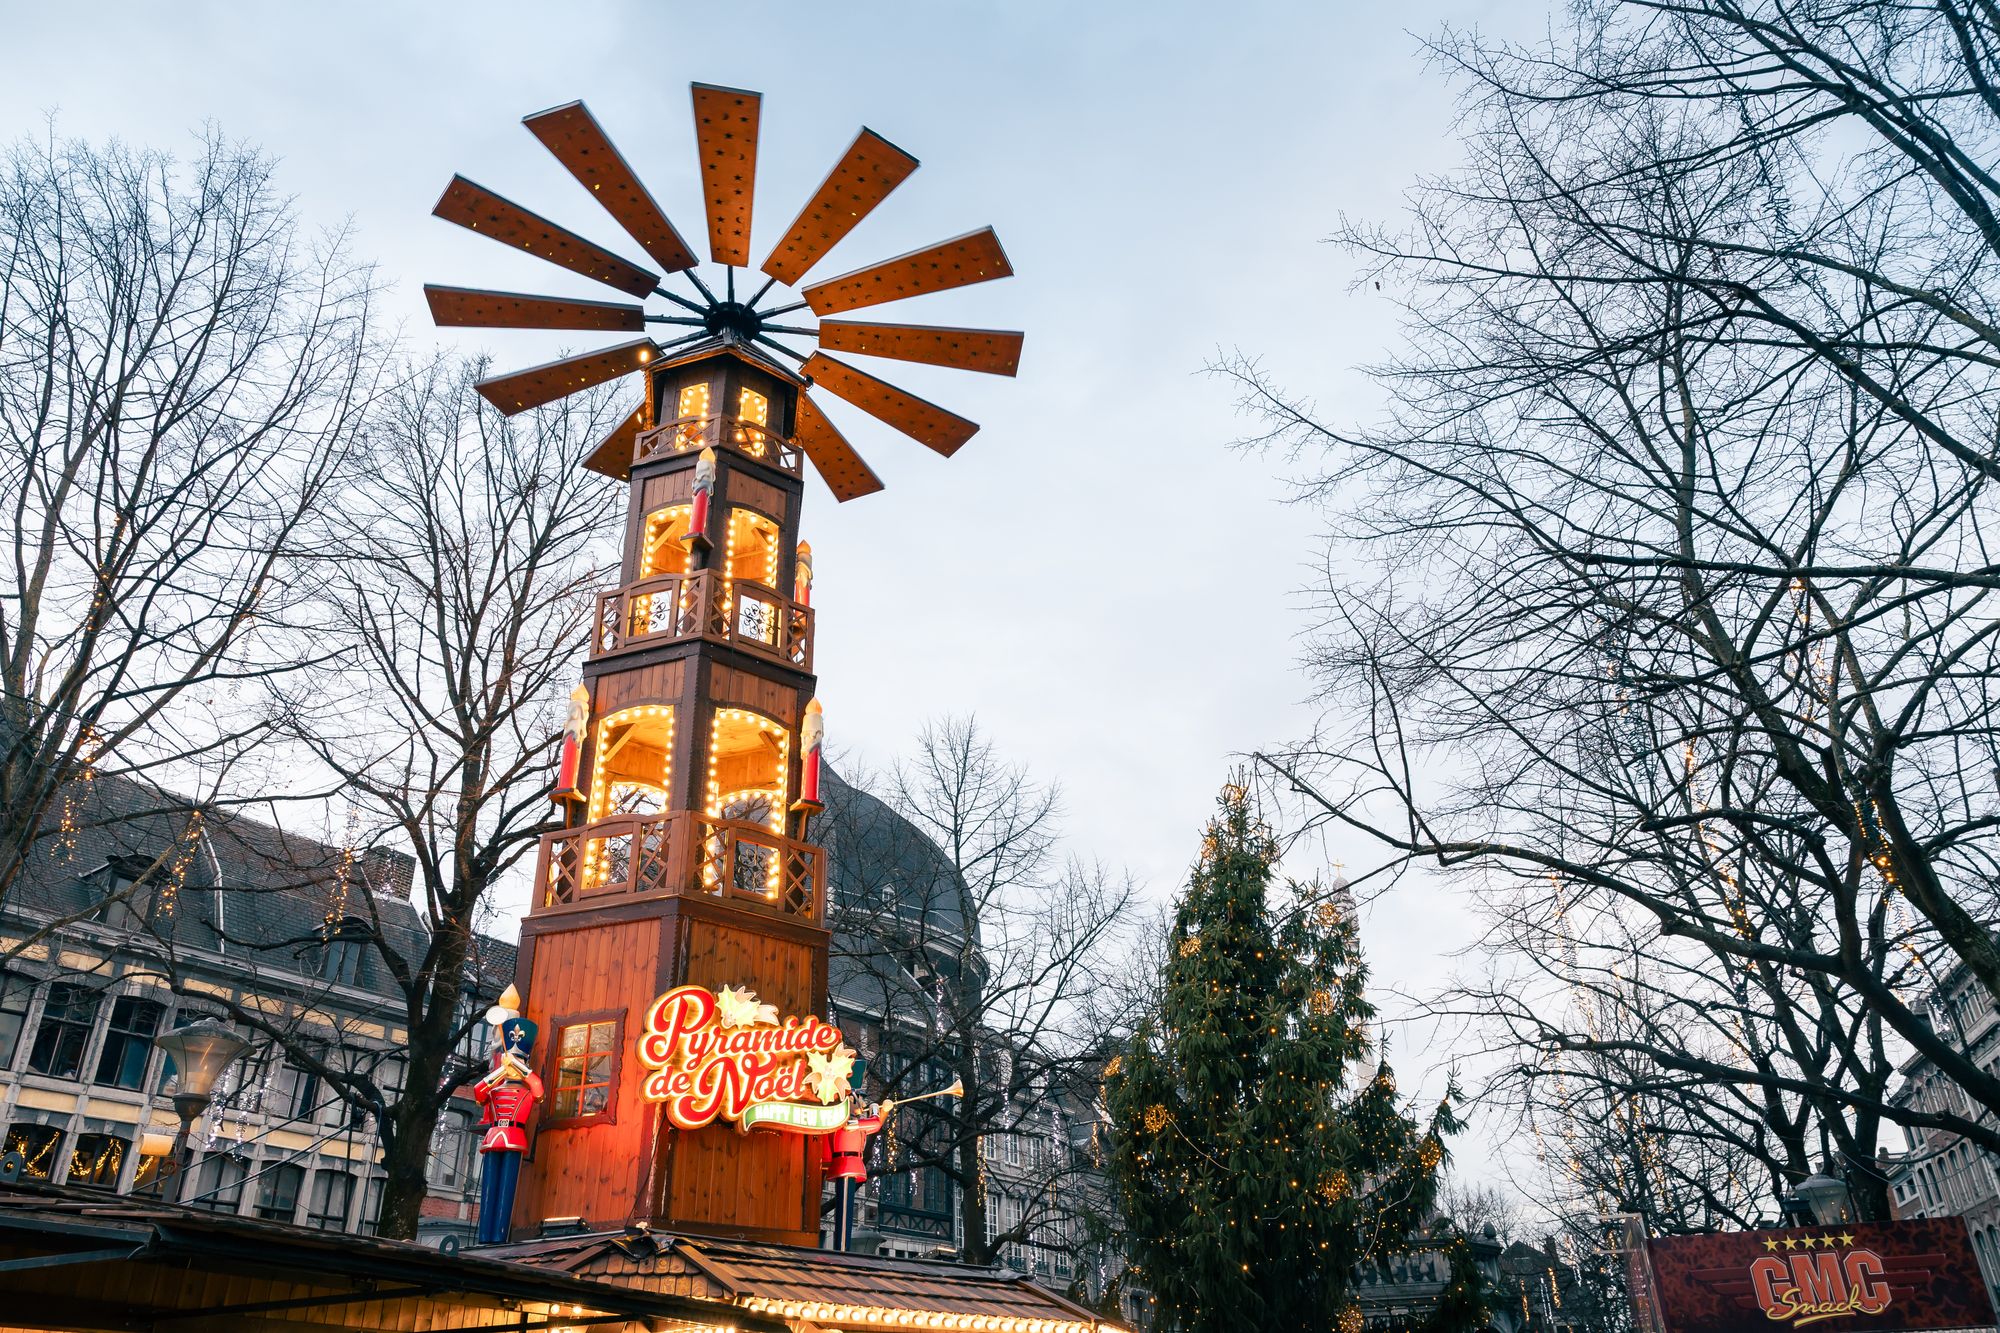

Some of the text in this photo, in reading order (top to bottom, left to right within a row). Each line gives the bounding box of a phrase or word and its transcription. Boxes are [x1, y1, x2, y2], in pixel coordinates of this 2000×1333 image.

[646, 989, 842, 1071] Pyramide
[650, 1052, 806, 1122] de Noël
[755, 1103, 791, 1121] HAPPY
[793, 1107, 817, 1126] NEW
[1750, 1249, 1892, 1315] GMC
[1766, 1283, 1883, 1320] Snack
